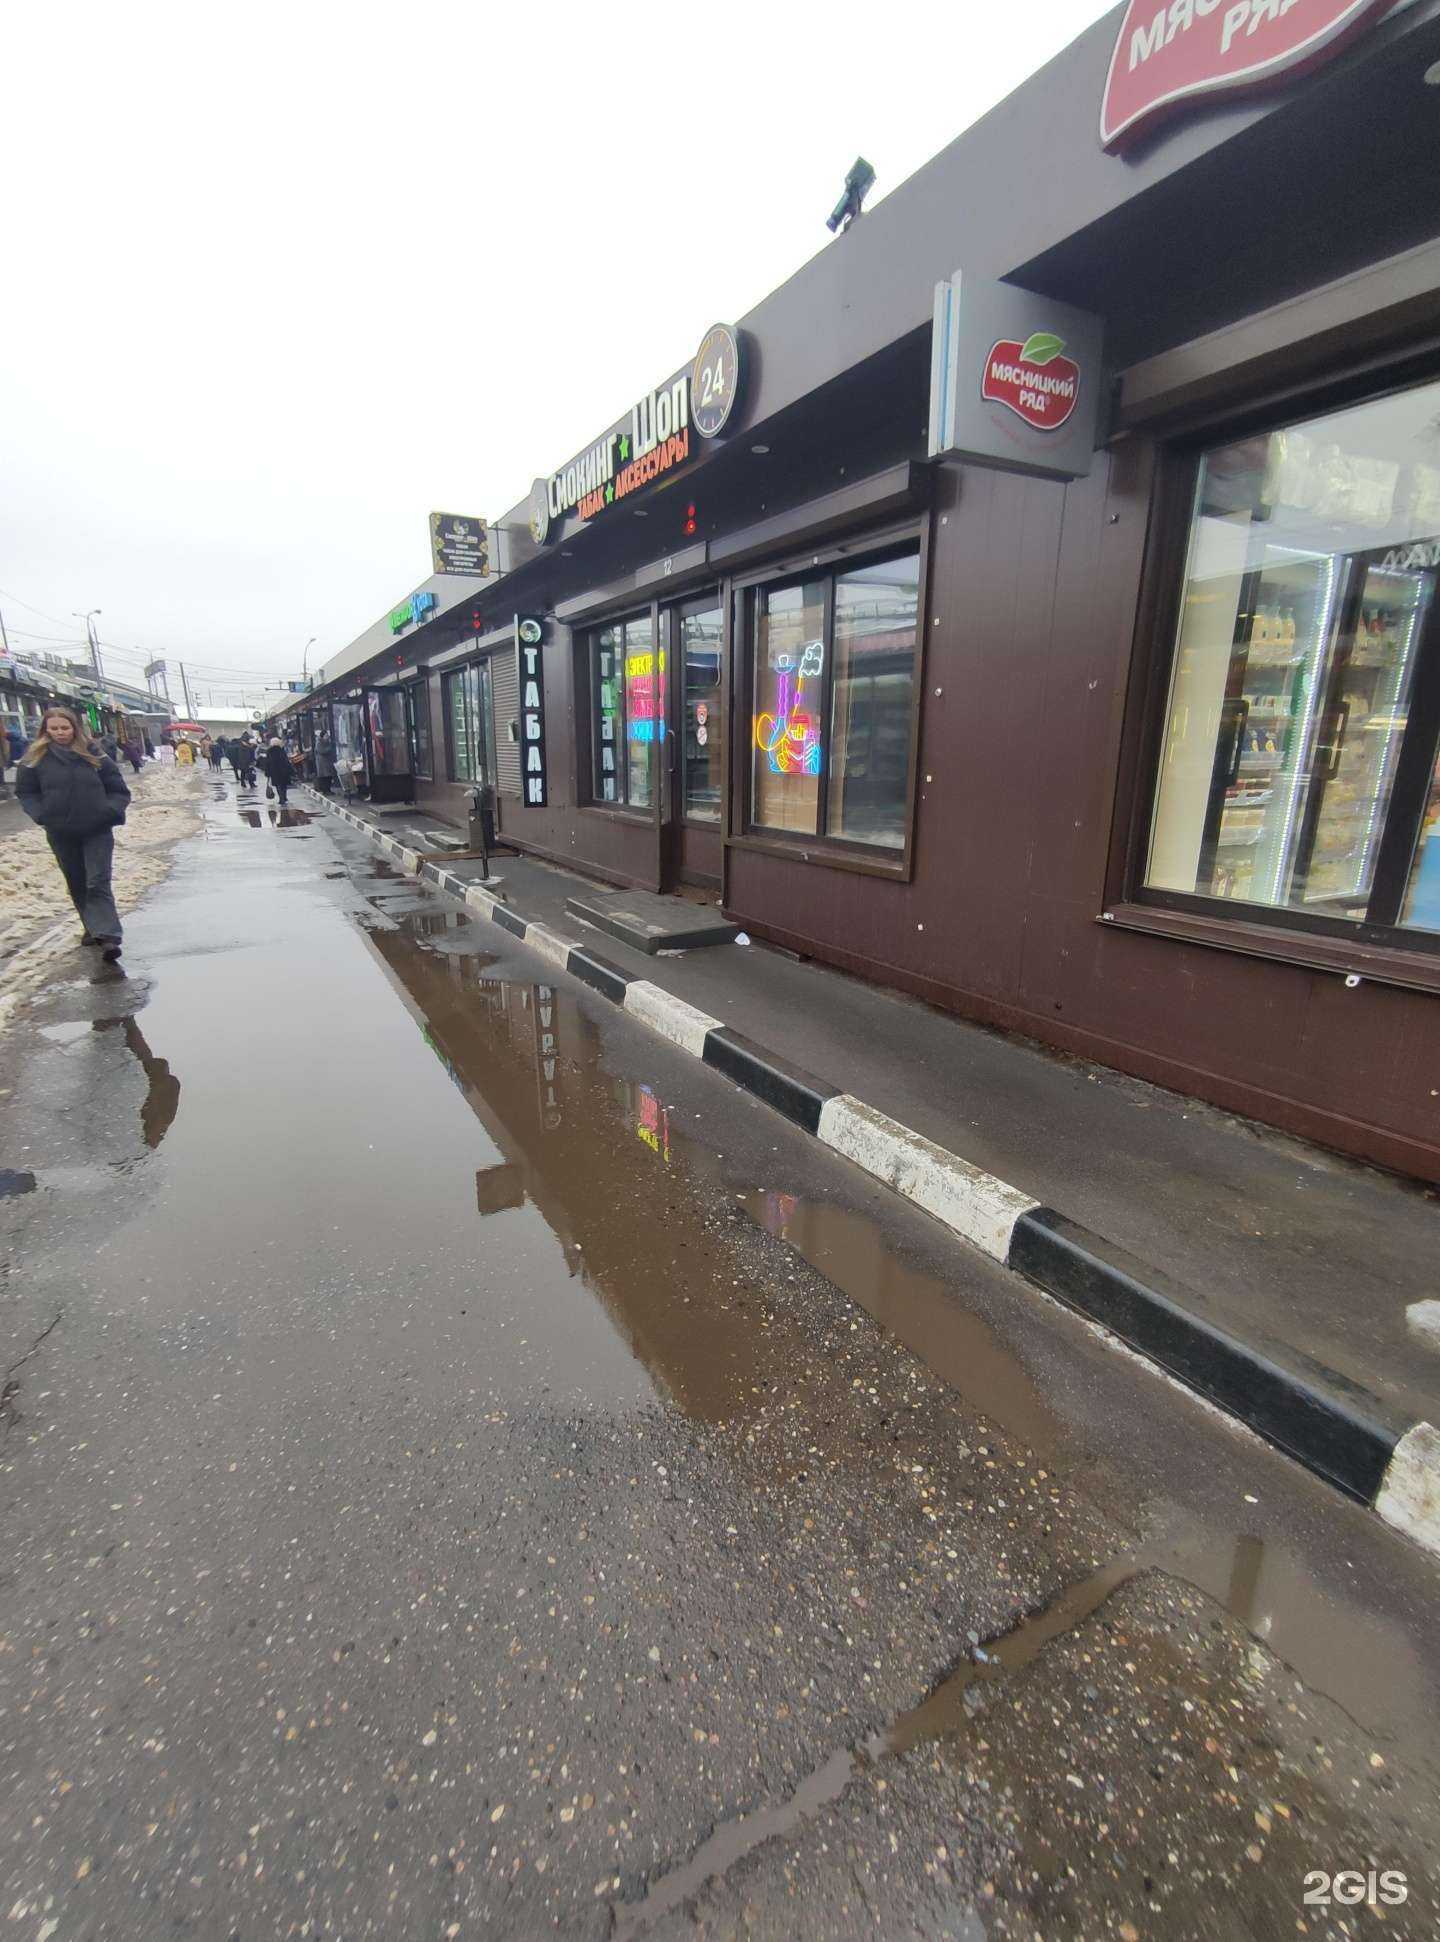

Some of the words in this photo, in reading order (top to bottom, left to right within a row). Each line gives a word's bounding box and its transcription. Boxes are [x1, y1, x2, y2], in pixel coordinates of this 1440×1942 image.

[1219, 0, 1299, 55] РЯ
[702, 356, 724, 407] 24
[991, 361, 1074, 398] МЯСНИЦКИЙ
[1019, 389, 1046, 413] РЯД
[577, 485, 605, 522] ТАБАК
[615, 427, 689, 500] АКСЕССУАРЫ
[524, 648, 543, 803] ТАБАК
